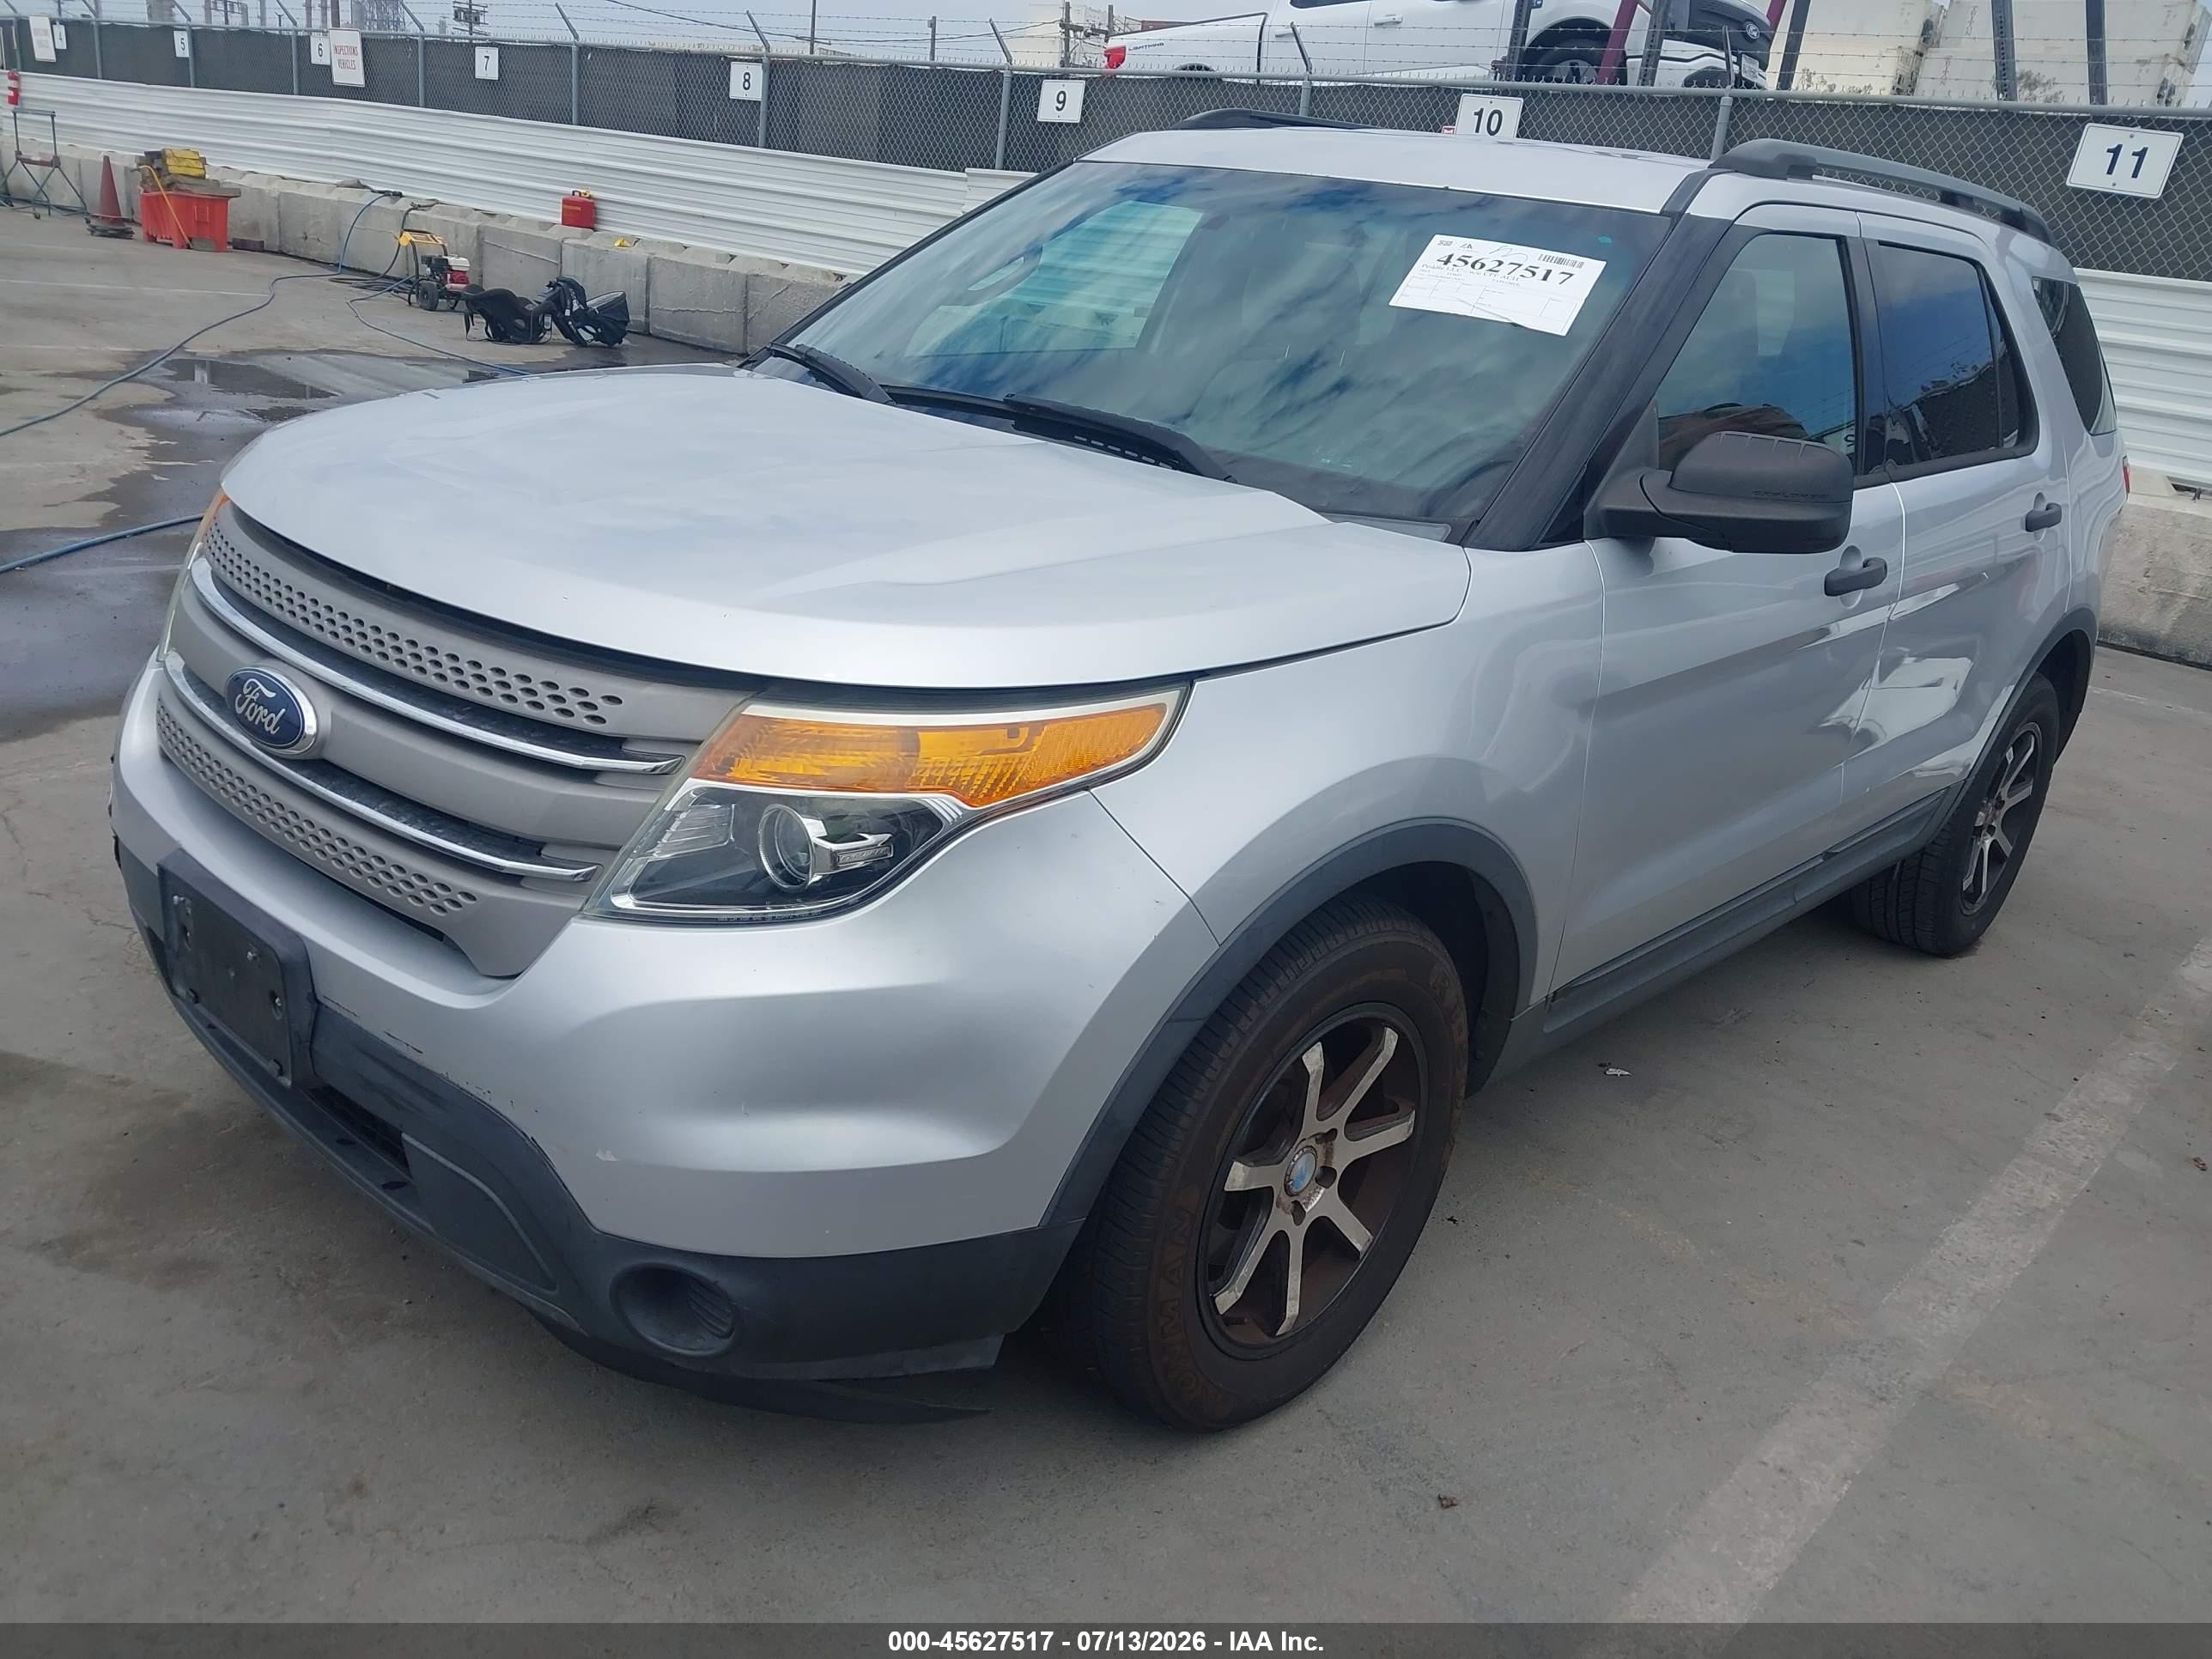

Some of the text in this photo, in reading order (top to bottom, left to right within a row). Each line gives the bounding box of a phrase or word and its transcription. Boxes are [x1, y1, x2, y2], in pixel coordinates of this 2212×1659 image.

[180, 38, 185, 52] 5
[318, 43, 324, 57] 6
[483, 55, 490, 70] 7
[742, 71, 751, 91] 8
[1054, 90, 1066, 112] 9
[1474, 107, 1504, 136] 10
[2106, 143, 2148, 179] 11
[1437, 252, 1575, 285] 45627517
[235, 678, 286, 734] Ford
